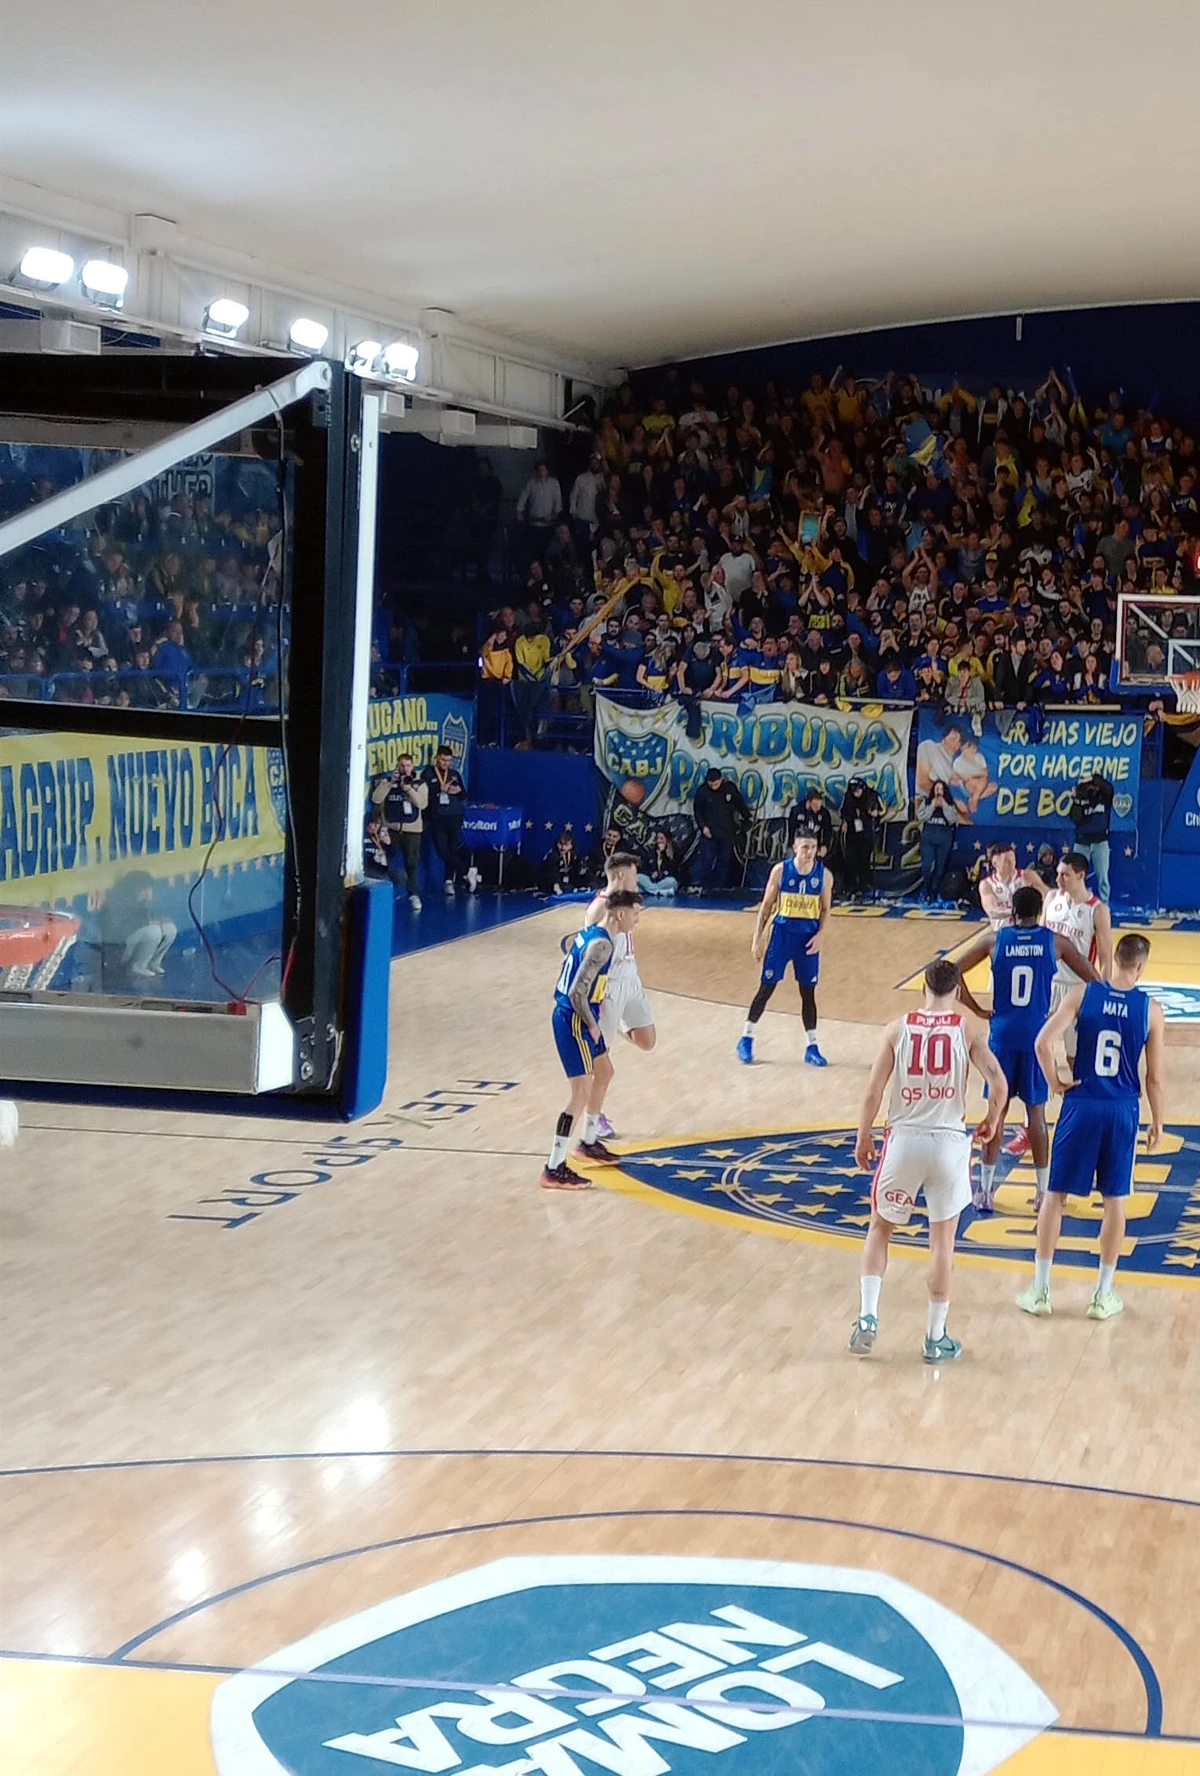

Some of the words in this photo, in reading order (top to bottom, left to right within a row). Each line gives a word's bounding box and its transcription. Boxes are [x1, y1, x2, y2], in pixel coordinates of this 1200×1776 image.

[1001, 720, 1080, 747] GRCIAS
[1086, 721, 1138, 747] VIEJO
[607, 752, 663, 778] CABJ
[997, 753, 1036, 781] POR
[1041, 755, 1130, 781] HACERME
[199, 744, 259, 845] BOCA
[997, 787, 1029, 816] DE
[1036, 787, 1072, 818] BO
[1005, 944, 1044, 957] LANGSTON
[1010, 964, 1034, 1007] 0
[1103, 1001, 1128, 1018] MATA
[907, 1032, 952, 1076] 10
[1094, 1030, 1122, 1077] 6
[362, 1078, 521, 1130] FLEX
[901, 1087, 922, 1106] gs
[928, 1083, 955, 1099] bio
[165, 1134, 404, 1230] SPORT
[884, 1191, 915, 1207] GEA
[321, 1603, 808, 1774] NEGRA
[450, 1641, 905, 1776] LOM
